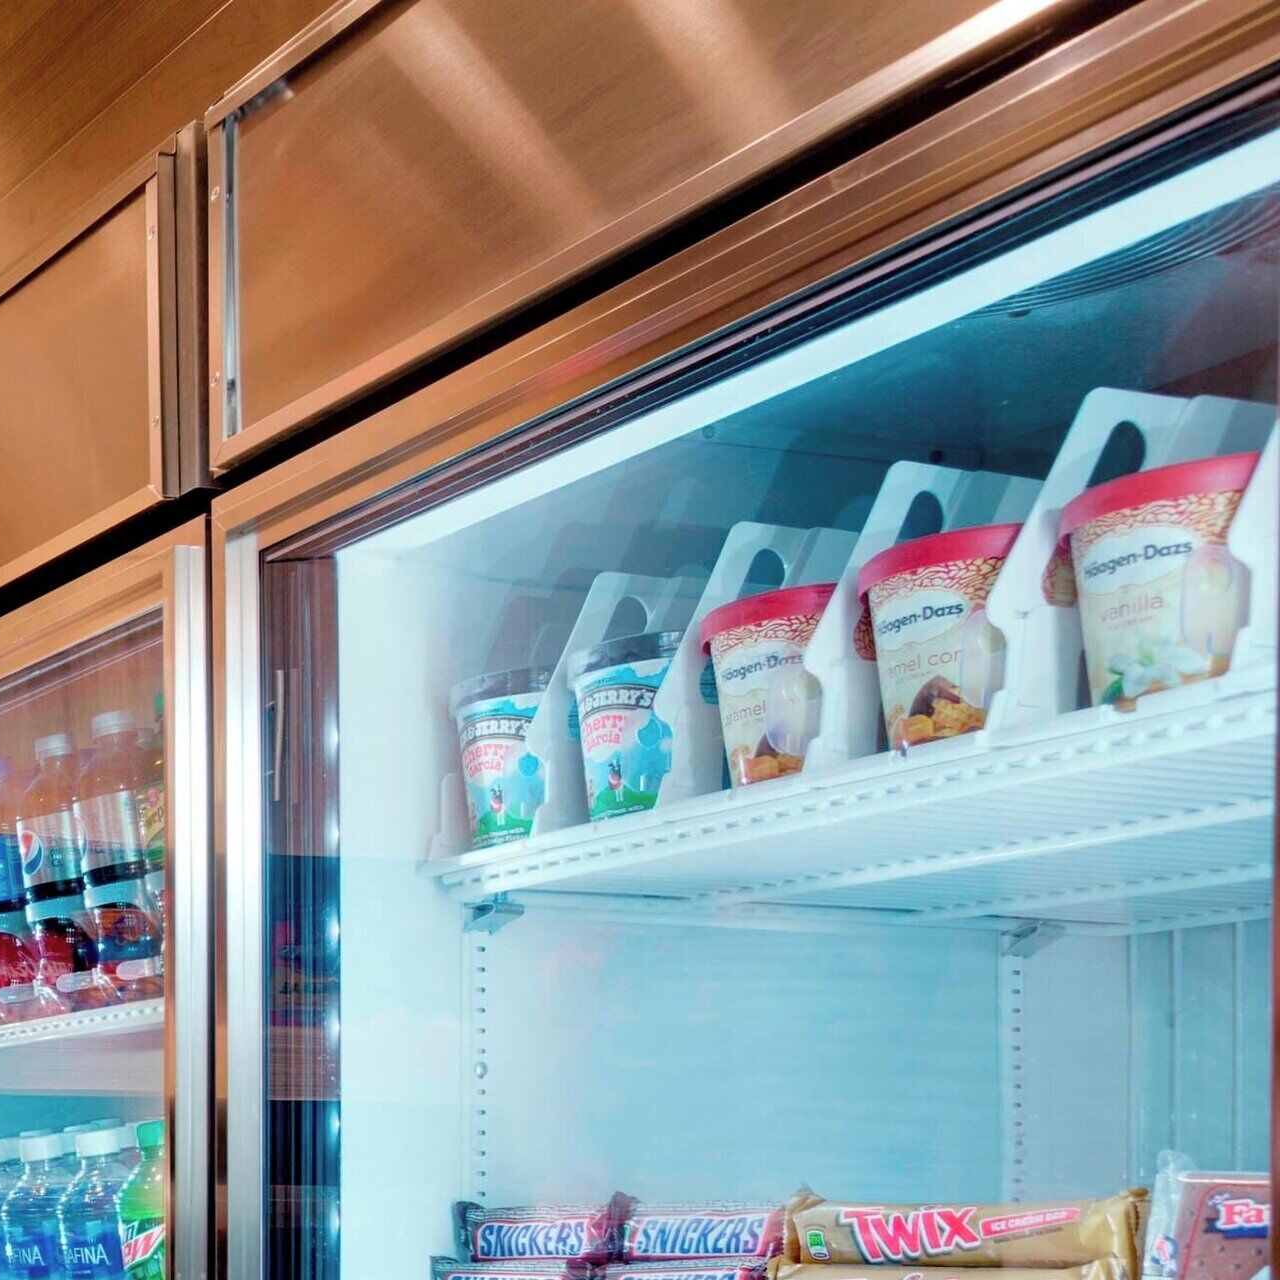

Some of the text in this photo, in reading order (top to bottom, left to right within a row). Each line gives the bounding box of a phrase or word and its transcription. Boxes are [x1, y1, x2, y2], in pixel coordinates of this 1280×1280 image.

[1098, 593, 1164, 623] vanilla
[479, 1221, 586, 1258] SNICKERS
[638, 1216, 765, 1256] SNICKERS
[840, 1204, 981, 1264] TWIX
